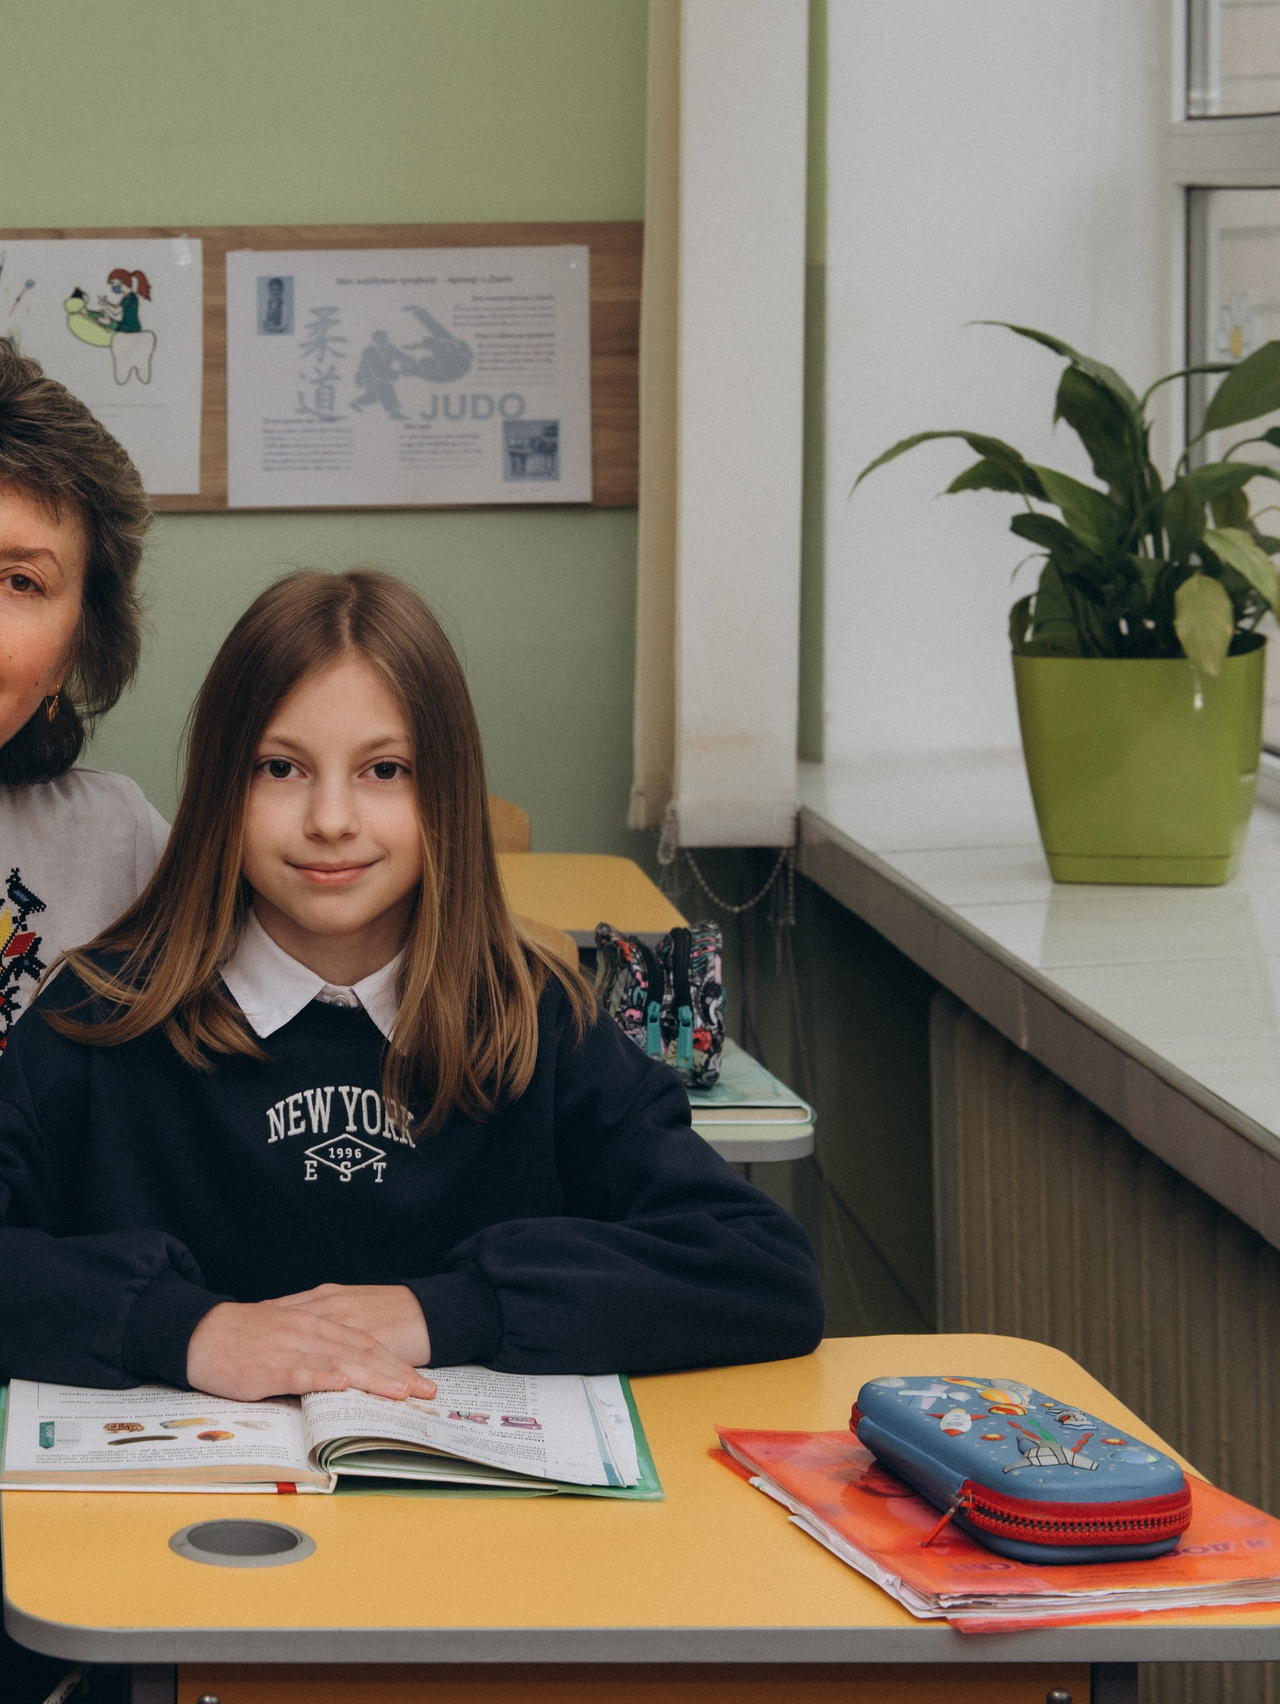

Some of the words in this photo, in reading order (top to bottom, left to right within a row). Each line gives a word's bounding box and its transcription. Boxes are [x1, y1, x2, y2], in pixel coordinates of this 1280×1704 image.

[420, 391, 528, 423] JUDO
[265, 1085, 336, 1144] NEW
[328, 1147, 363, 1160] 1996
